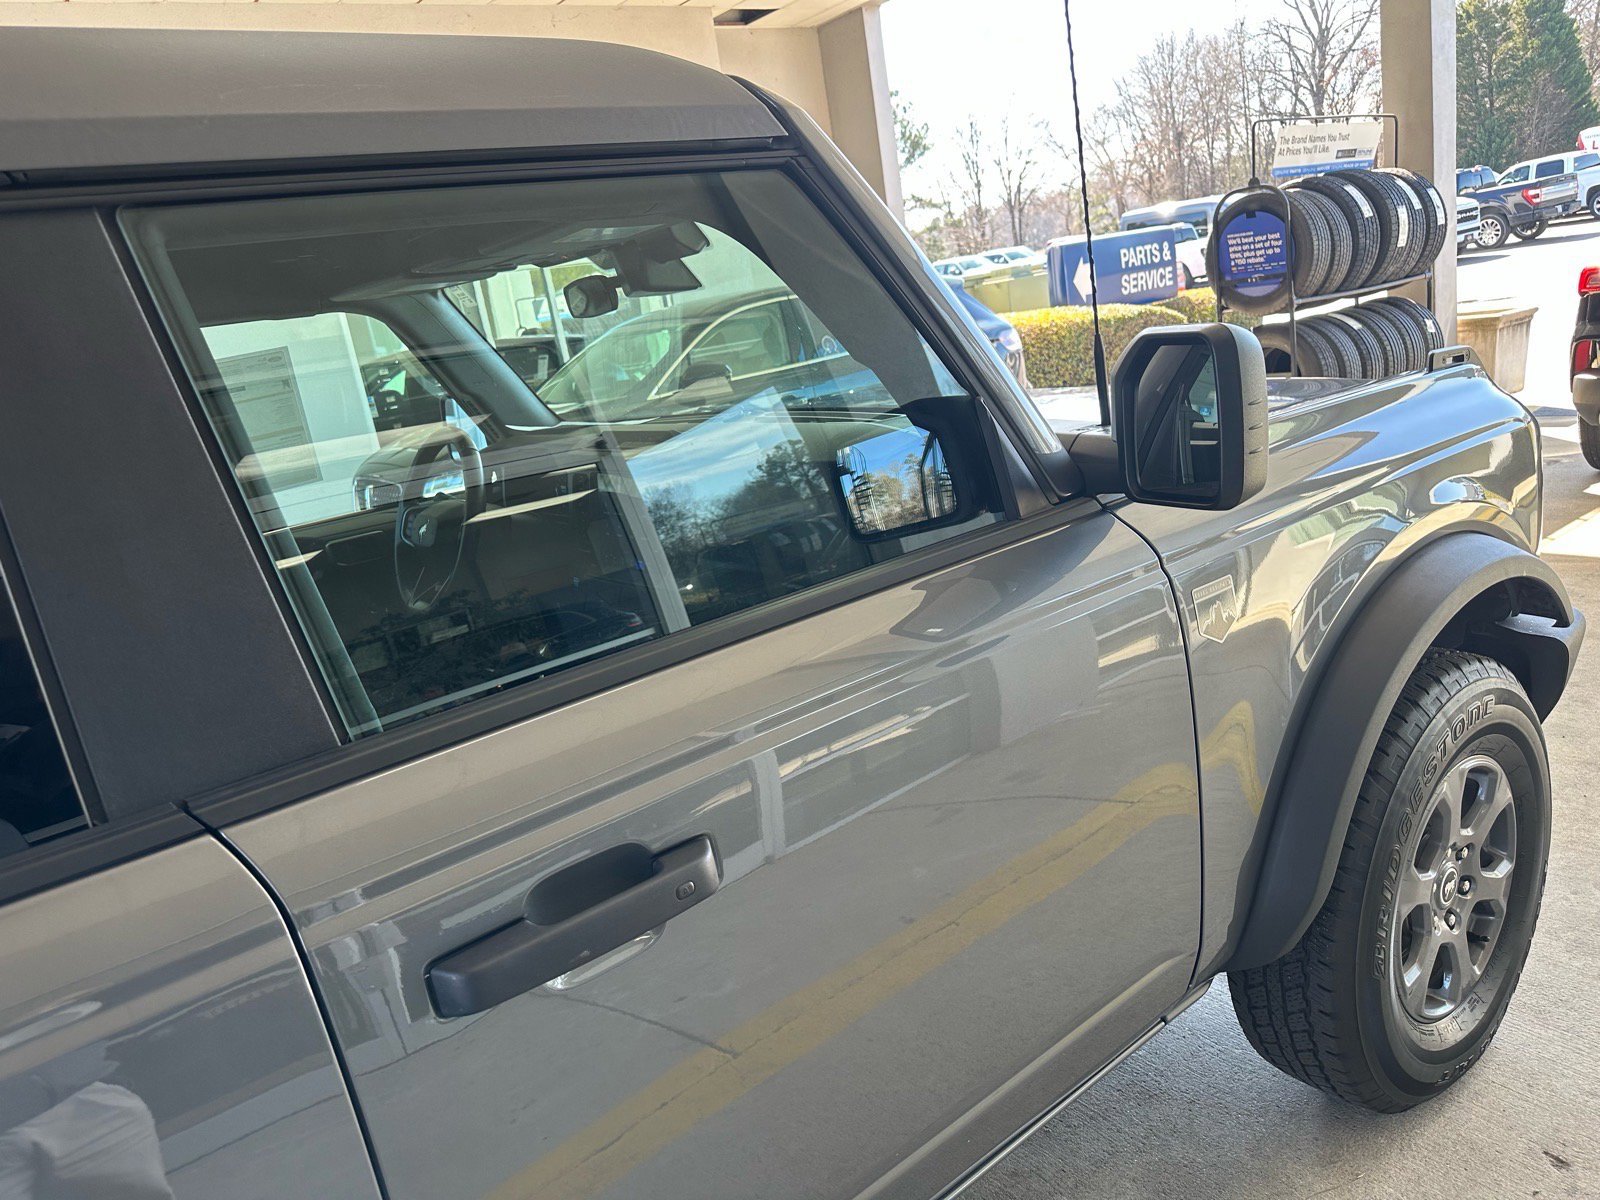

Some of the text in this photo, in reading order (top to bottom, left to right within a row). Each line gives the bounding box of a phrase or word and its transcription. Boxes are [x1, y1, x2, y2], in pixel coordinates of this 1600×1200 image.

[1278, 148, 1285, 156] At
[1286, 147, 1301, 156] Prices
[1280, 132, 1350, 145] The Brand Names You Trust
[1120, 241, 1172, 269] PARTS &
[1121, 266, 1174, 296] SERVICE
[1371, 694, 1497, 981] BRIDGESTONE
